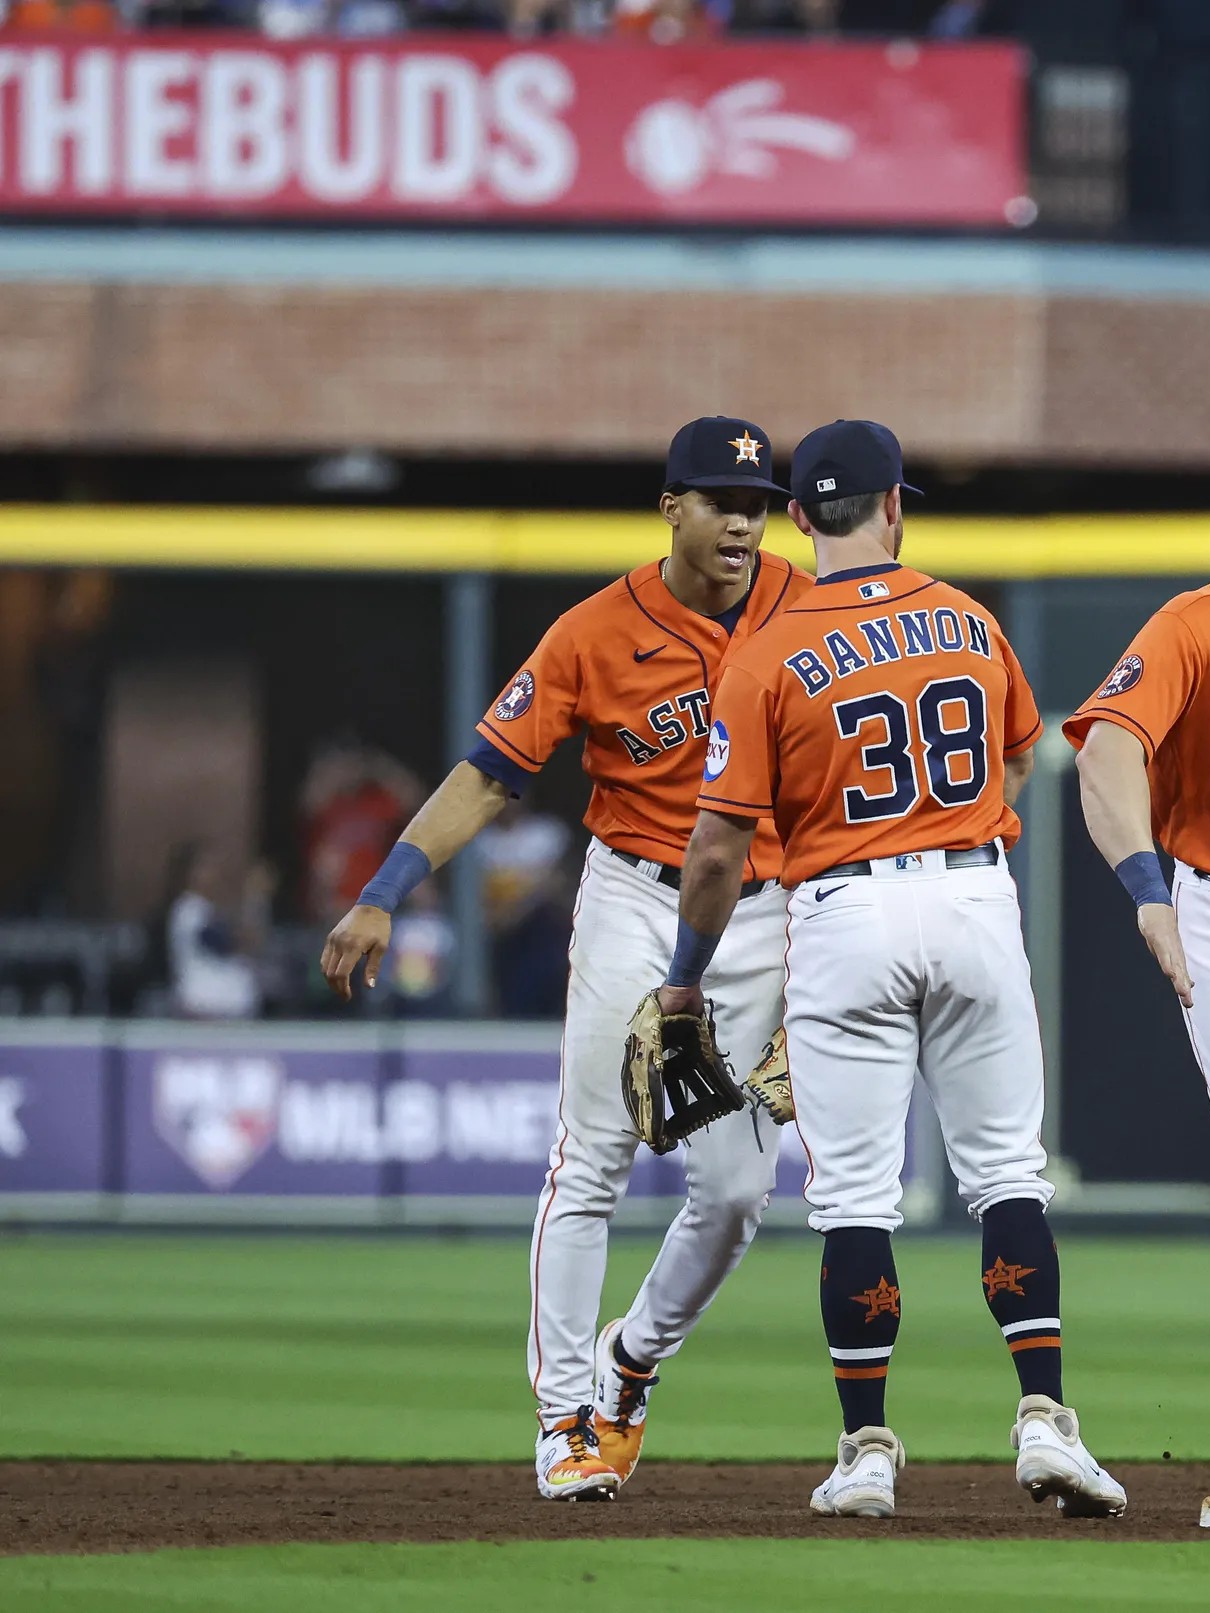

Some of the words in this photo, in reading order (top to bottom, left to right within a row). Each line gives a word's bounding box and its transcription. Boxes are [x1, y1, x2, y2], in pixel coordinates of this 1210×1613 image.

[735, 437, 760, 461] H
[784, 607, 992, 698] BANNON
[832, 675, 988, 824] 38
[284, 1078, 440, 1164] MLB
[446, 1080, 559, 1164] NE
